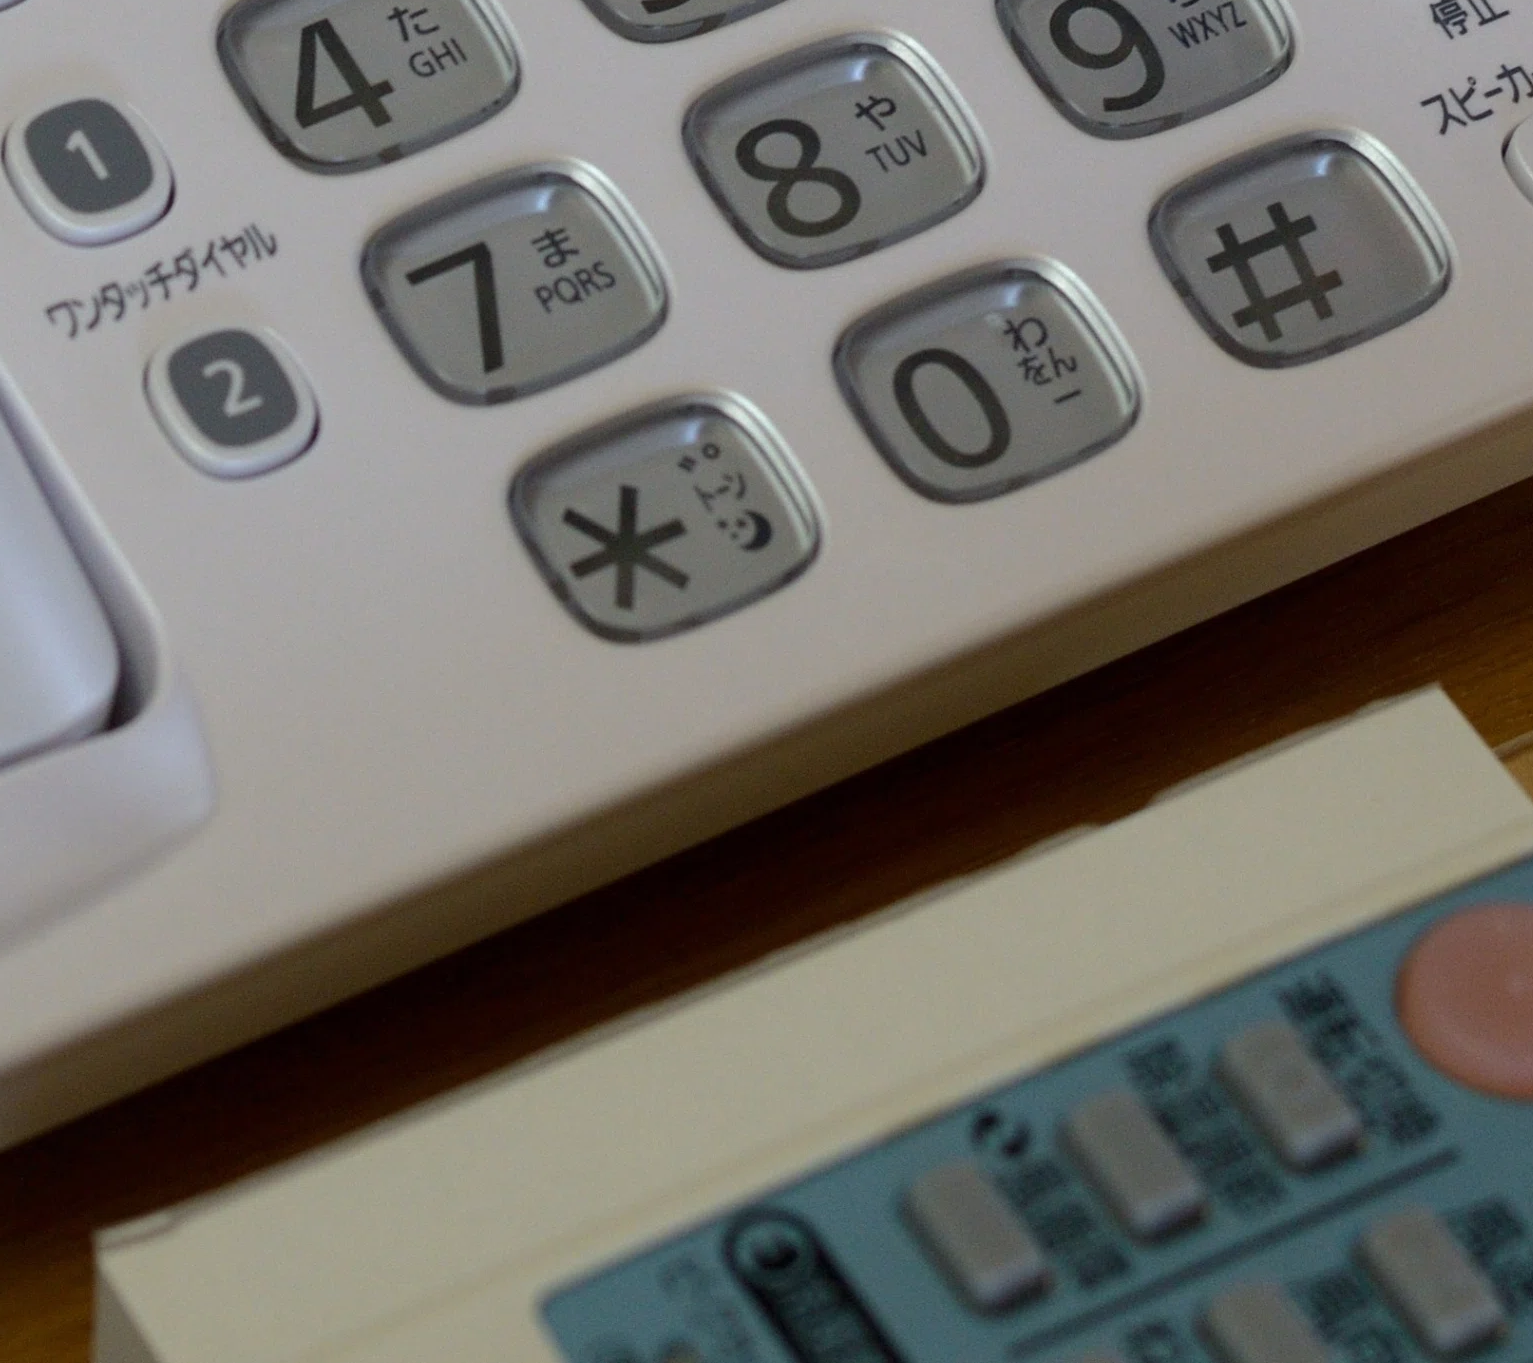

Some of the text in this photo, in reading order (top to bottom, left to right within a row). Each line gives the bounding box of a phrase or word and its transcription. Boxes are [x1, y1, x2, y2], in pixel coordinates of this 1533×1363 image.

[387, 6, 439, 42] た
[1168, 0, 1248, 50] WXYZ
[295, 18, 394, 129] 4
[409, 38, 468, 77] GHI
[855, 94, 899, 132] や
[65, 129, 110, 180] 1
[736, 117, 862, 239] 8
[866, 129, 929, 175] TUV
[532, 226, 579, 269] ま
[1206, 201, 1344, 343] #
[44, 223, 279, 340] ワンタッチダイヤル
[405, 241, 504, 374] 7
[533, 260, 616, 313] PQRS
[1004, 315, 1050, 354] わ
[203, 358, 263, 417] 2
[892, 347, 1013, 470] 0
